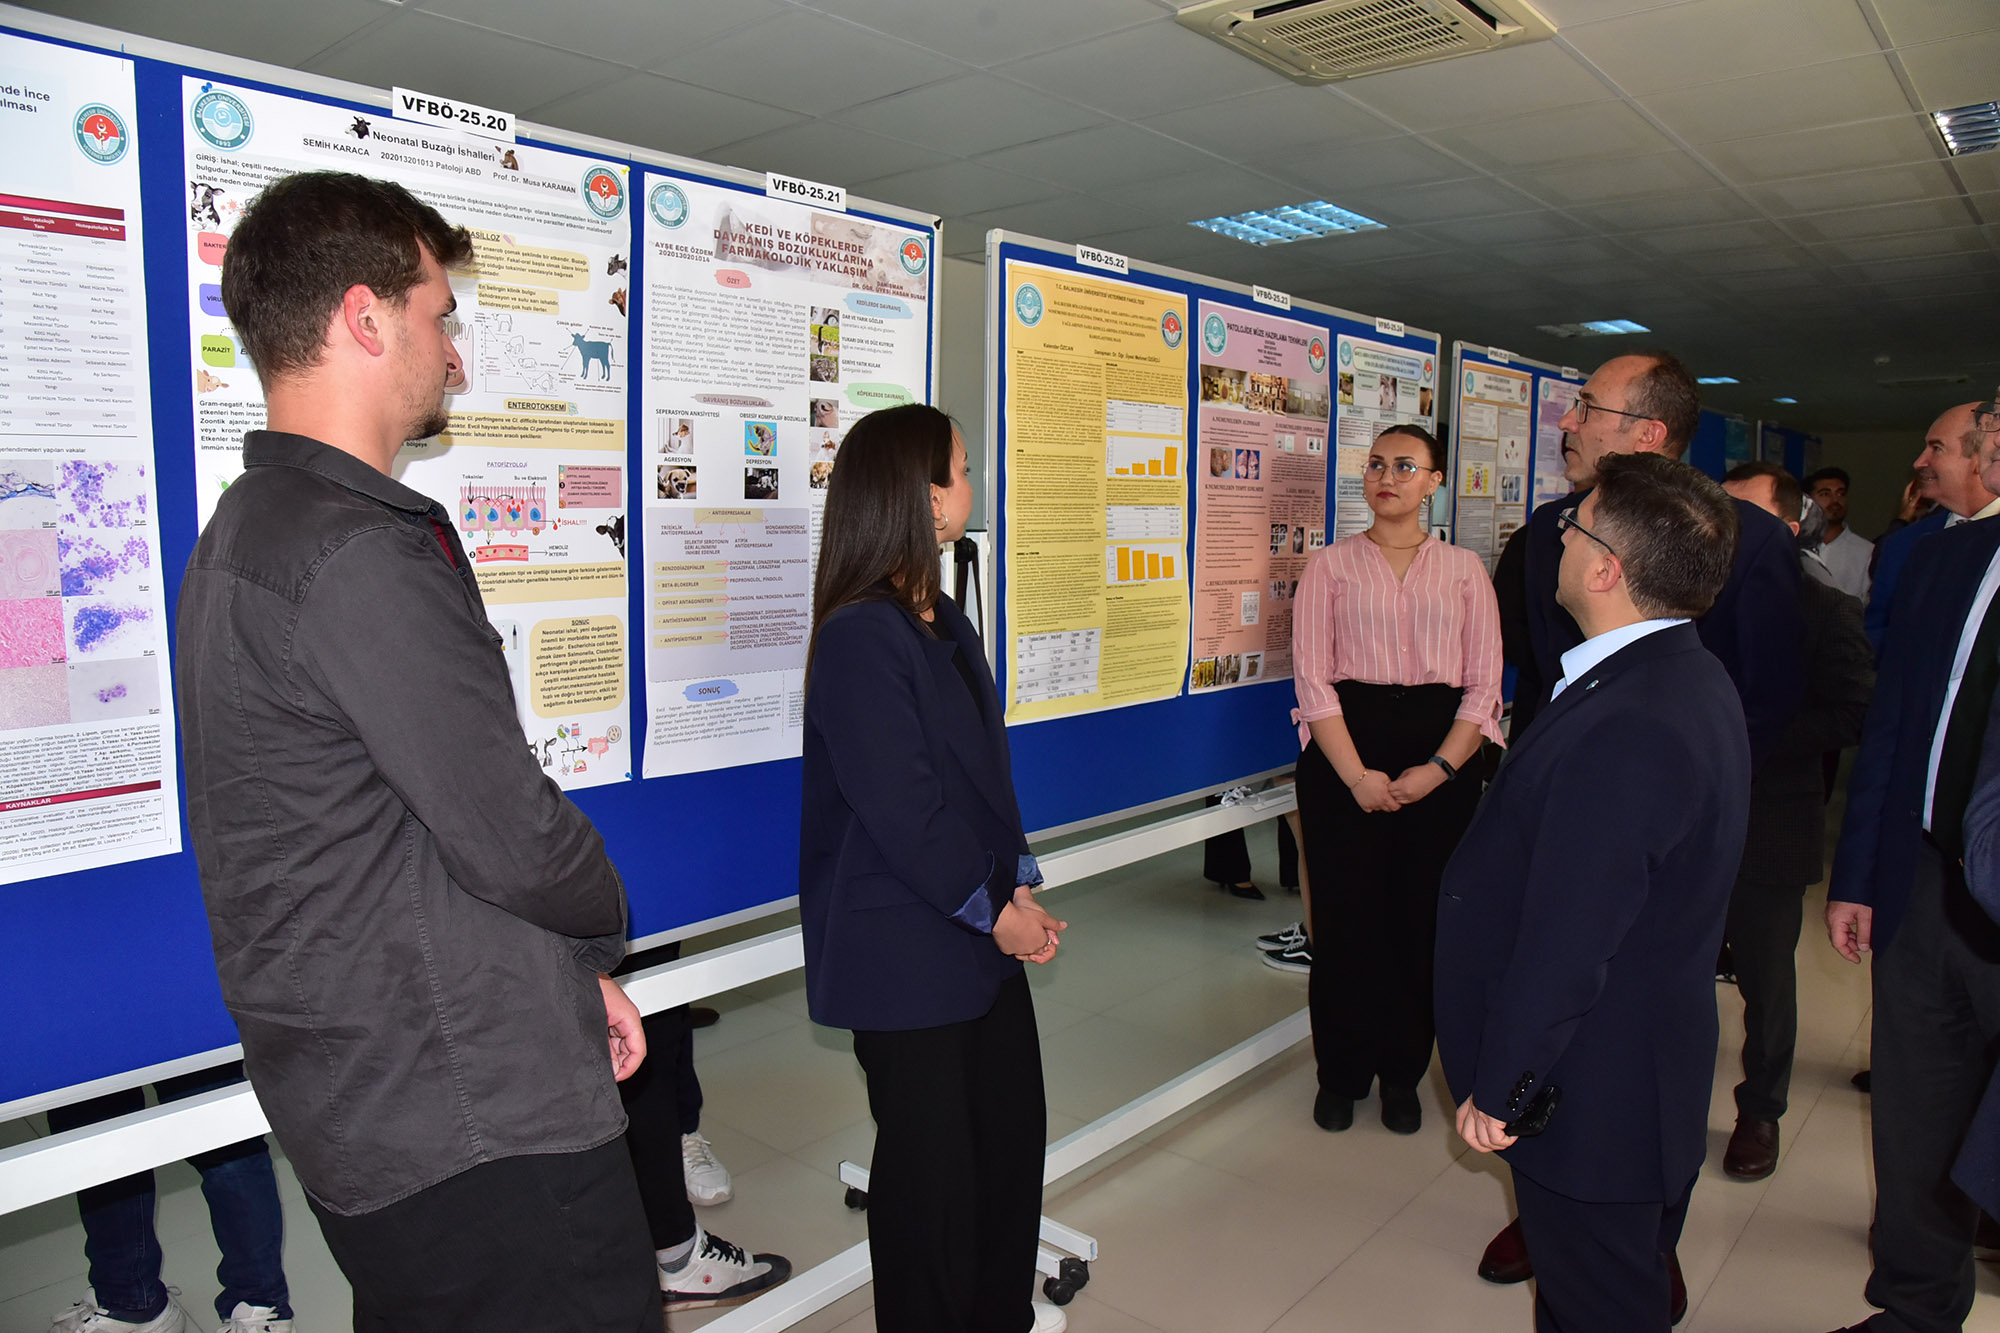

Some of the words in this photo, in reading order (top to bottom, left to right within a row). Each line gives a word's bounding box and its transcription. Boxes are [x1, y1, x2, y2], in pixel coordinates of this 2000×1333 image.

[24, 86, 50, 101] İnce
[402, 95, 507, 132] VFBÖ-25.20
[303, 138, 331, 149] SEMİH
[333, 143, 370, 156] KARACA
[372, 131, 419, 148] Neonatal
[422, 140, 455, 155] Buzağı
[458, 145, 495, 162] İshalleri
[380, 152, 434, 168] 202013201013
[436, 162, 464, 173] Patoloji
[465, 167, 481, 176] ABD
[196, 174, 217, 182] ishale
[220, 177, 241, 185] neden
[243, 181, 266, 189] olmakt
[232, 169, 262, 180] Neonatal
[493, 172, 510, 182] Prof.
[511, 175, 521, 184] Dr.
[523, 177, 541, 187] Musa
[542, 181, 576, 194] KARAMAN
[773, 179, 840, 203] VFBÖ-25.21
[470, 231, 500, 242] ASİLLOZ
[746, 222, 773, 237] KEDİ
[777, 229, 791, 240] VE
[795, 231, 864, 255] KÖPEKLERDE
[655, 241, 673, 251] AYŞE
[675, 244, 689, 252] ECE
[714, 229, 774, 251] DAVRANIŞ
[778, 241, 874, 268] BOZUKLUKLARINA
[722, 244, 812, 268] FARMAKOLOJİK
[815, 260, 868, 279] YAKLAŞIM
[1080, 249, 1125, 268] VFBÖ-25.22
[727, 276, 740, 285] ÖZET
[1256, 289, 1288, 304] VFBÖ-25.23
[202, 345, 230, 353] PARAZİT
[698, 686, 721, 695] SONUÇ
[5, 798, 51, 809] KAYNAKLAR
